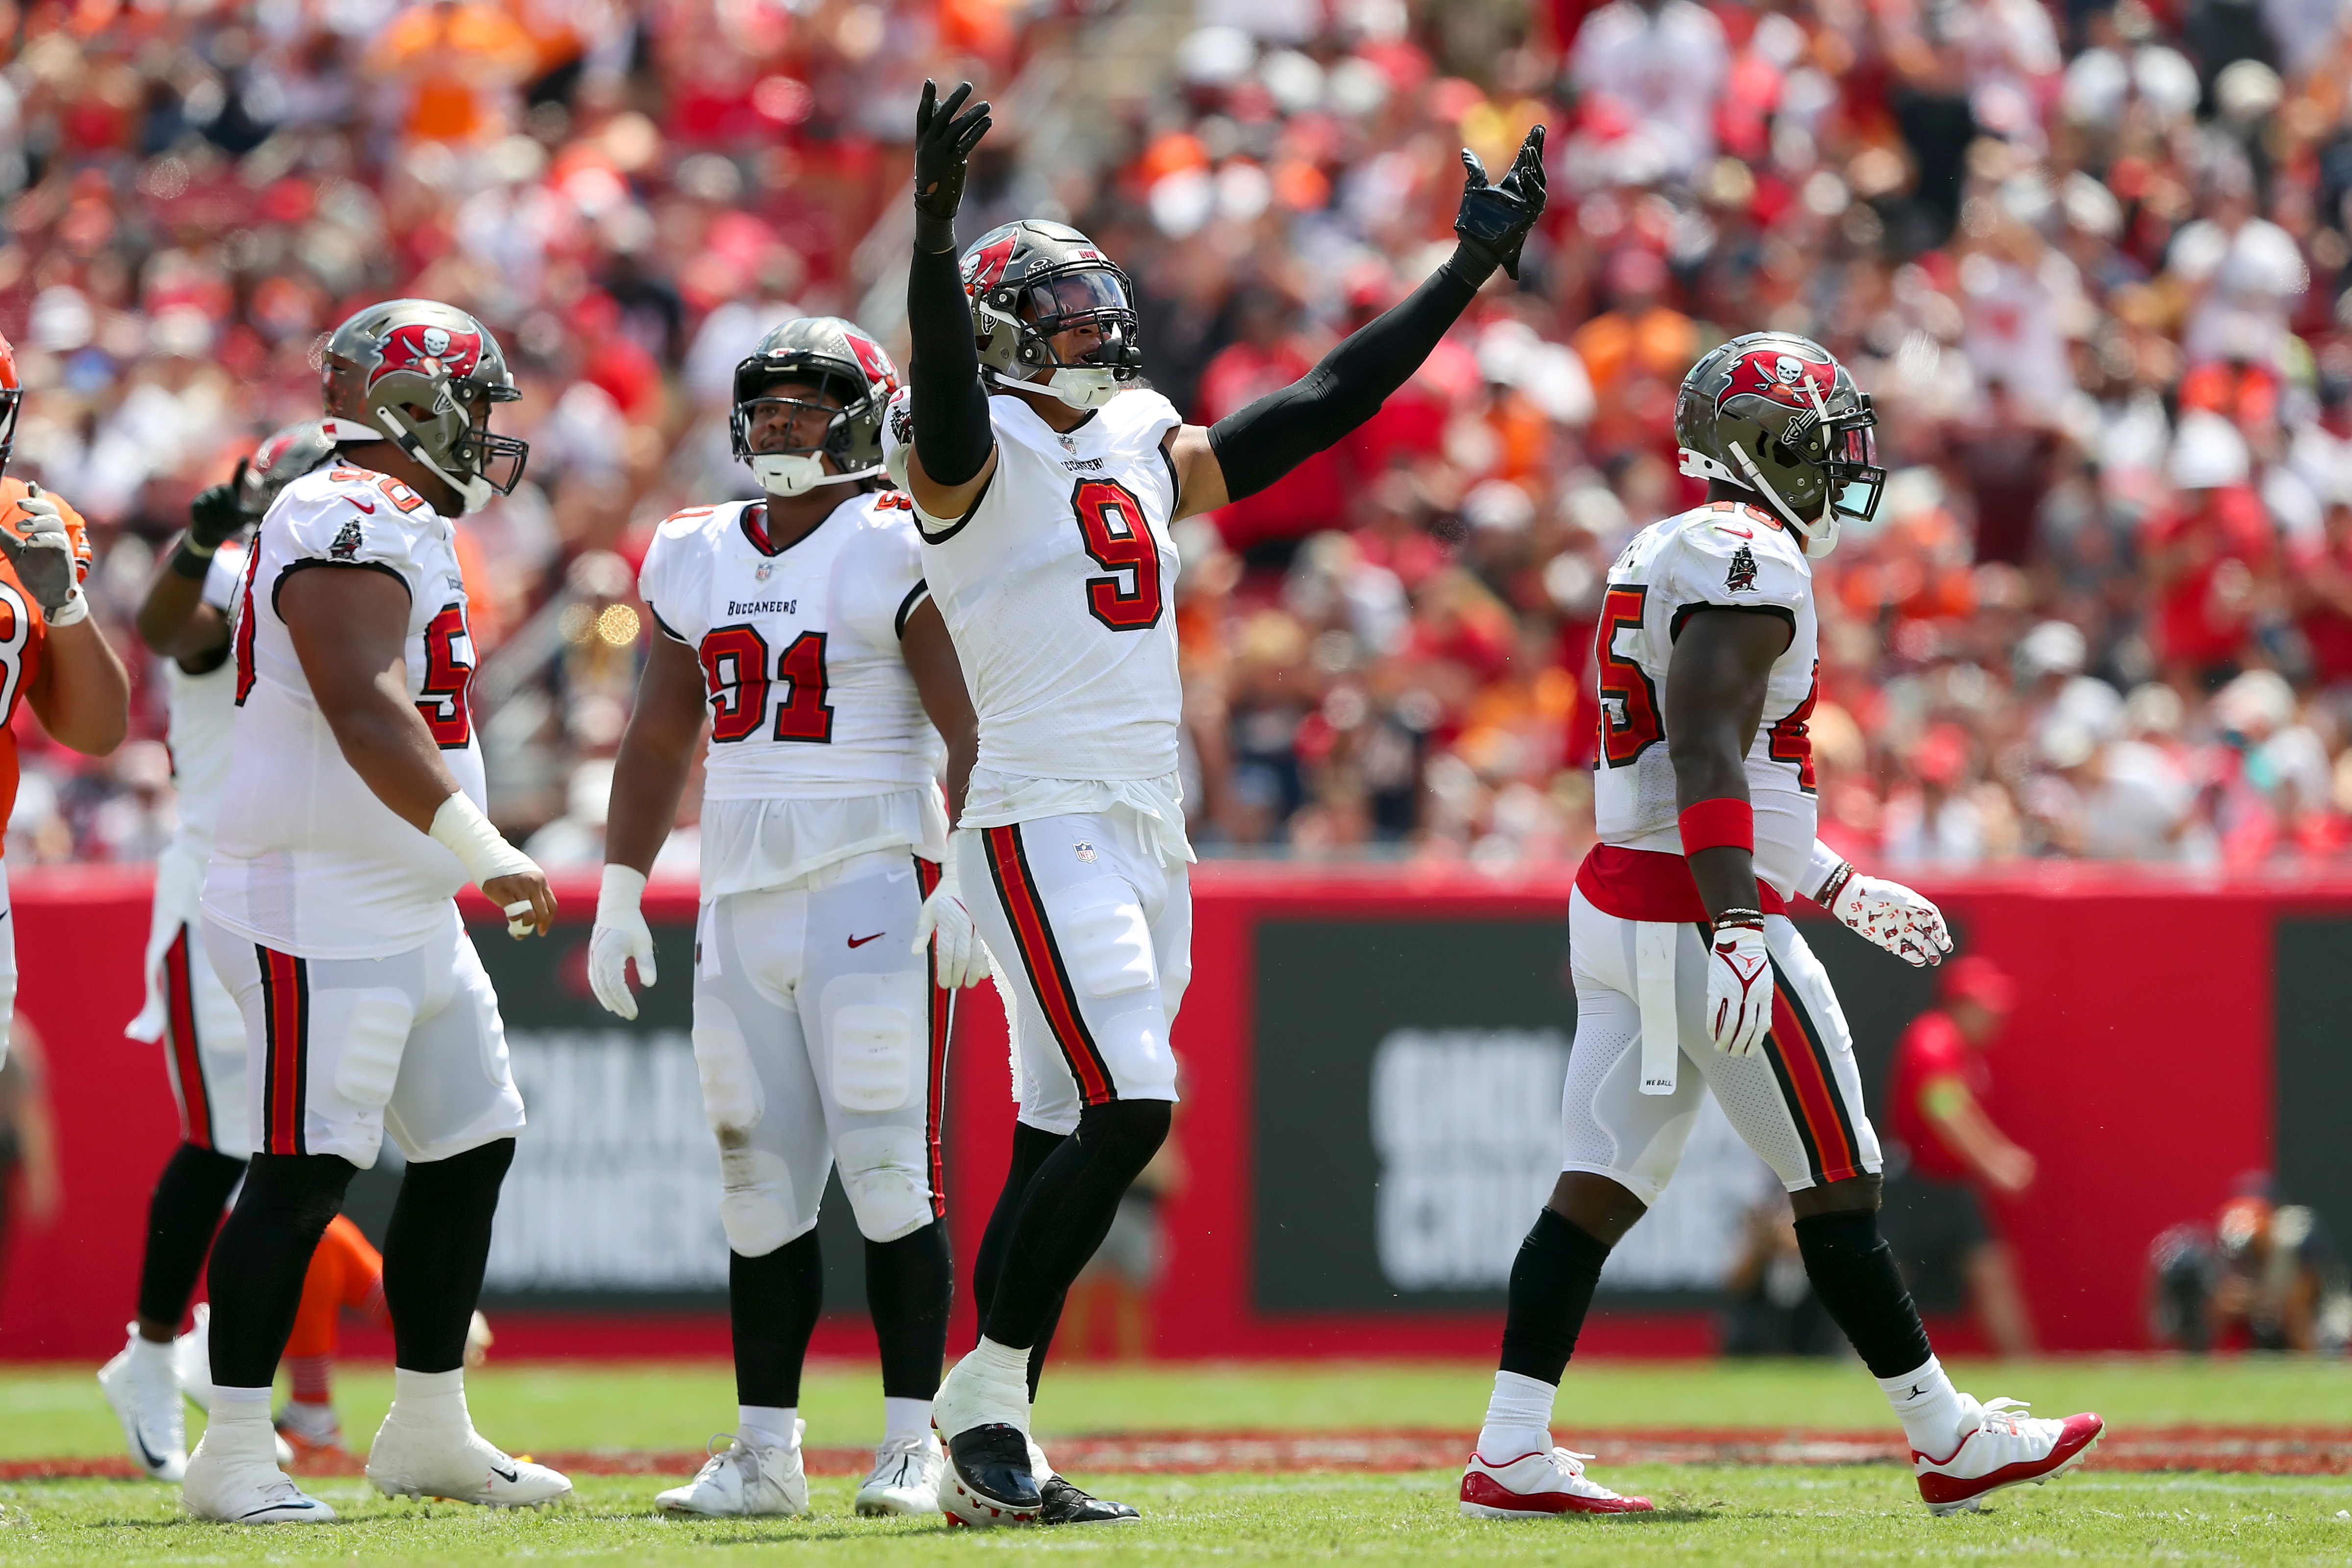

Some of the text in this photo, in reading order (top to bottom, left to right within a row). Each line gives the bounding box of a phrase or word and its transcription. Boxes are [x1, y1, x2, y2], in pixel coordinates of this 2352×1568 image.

[727, 599, 797, 617] BUCCANEERS
[1070, 478, 1163, 632] 9
[699, 624, 835, 743] 91
[1594, 584, 1665, 769] 5
[1079, 851, 1095, 859] NFL
